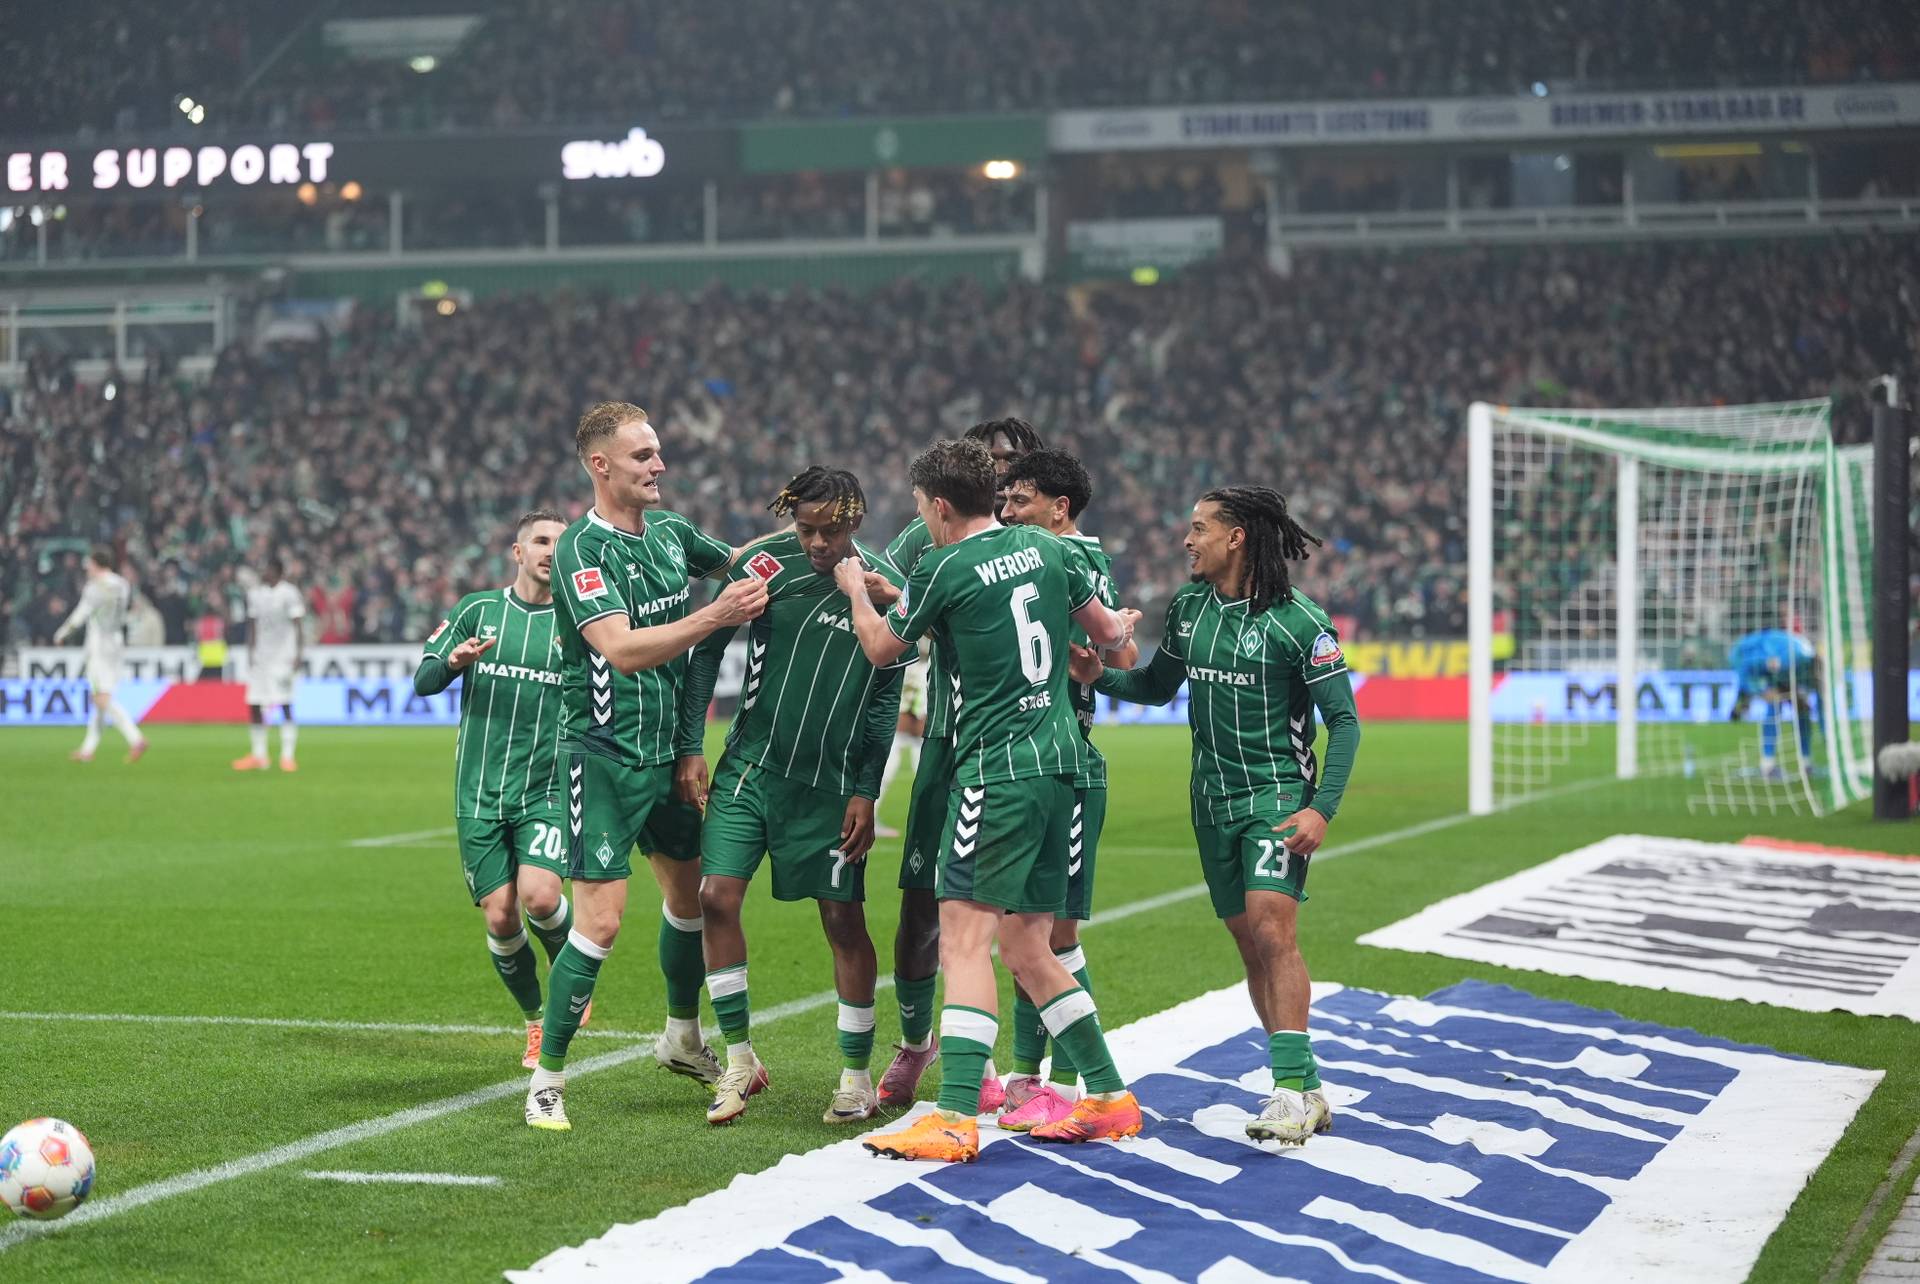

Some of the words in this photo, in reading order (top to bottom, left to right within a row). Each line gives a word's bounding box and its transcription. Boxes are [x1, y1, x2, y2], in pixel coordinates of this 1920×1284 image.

[93, 142, 334, 189] SUPPORT
[577, 127, 665, 179] swb
[974, 546, 1045, 586] WERDER
[817, 611, 857, 634] MA
[1010, 581, 1053, 688] 6
[1019, 691, 1051, 712] STAGE
[528, 823, 562, 860] 20
[1254, 839, 1291, 879] 23
[829, 849, 847, 888] 7
